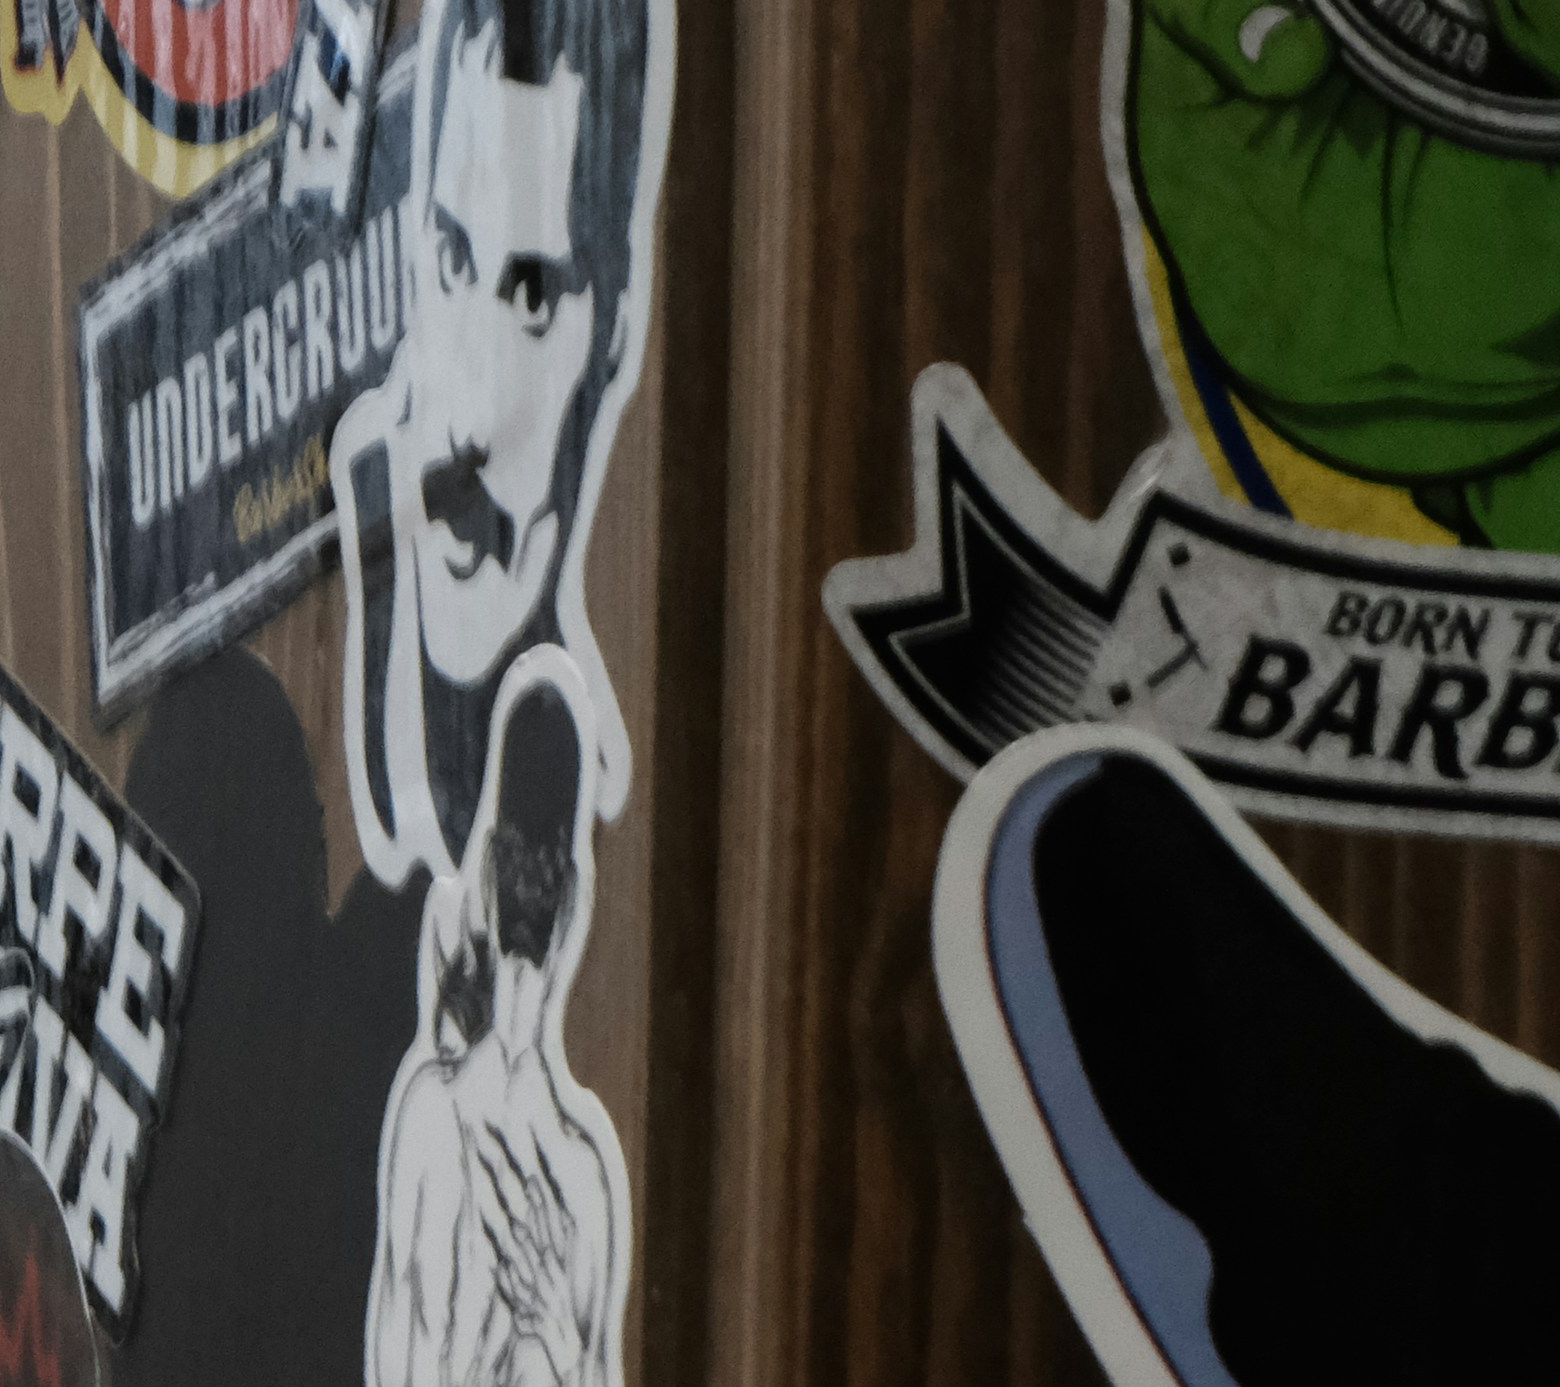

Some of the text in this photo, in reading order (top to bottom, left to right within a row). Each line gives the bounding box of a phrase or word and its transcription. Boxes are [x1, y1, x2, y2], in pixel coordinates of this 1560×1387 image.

[128, 206, 420, 530] UNDERGROU
[1323, 590, 1560, 664] BORN T
[1213, 632, 1560, 780] BARB
